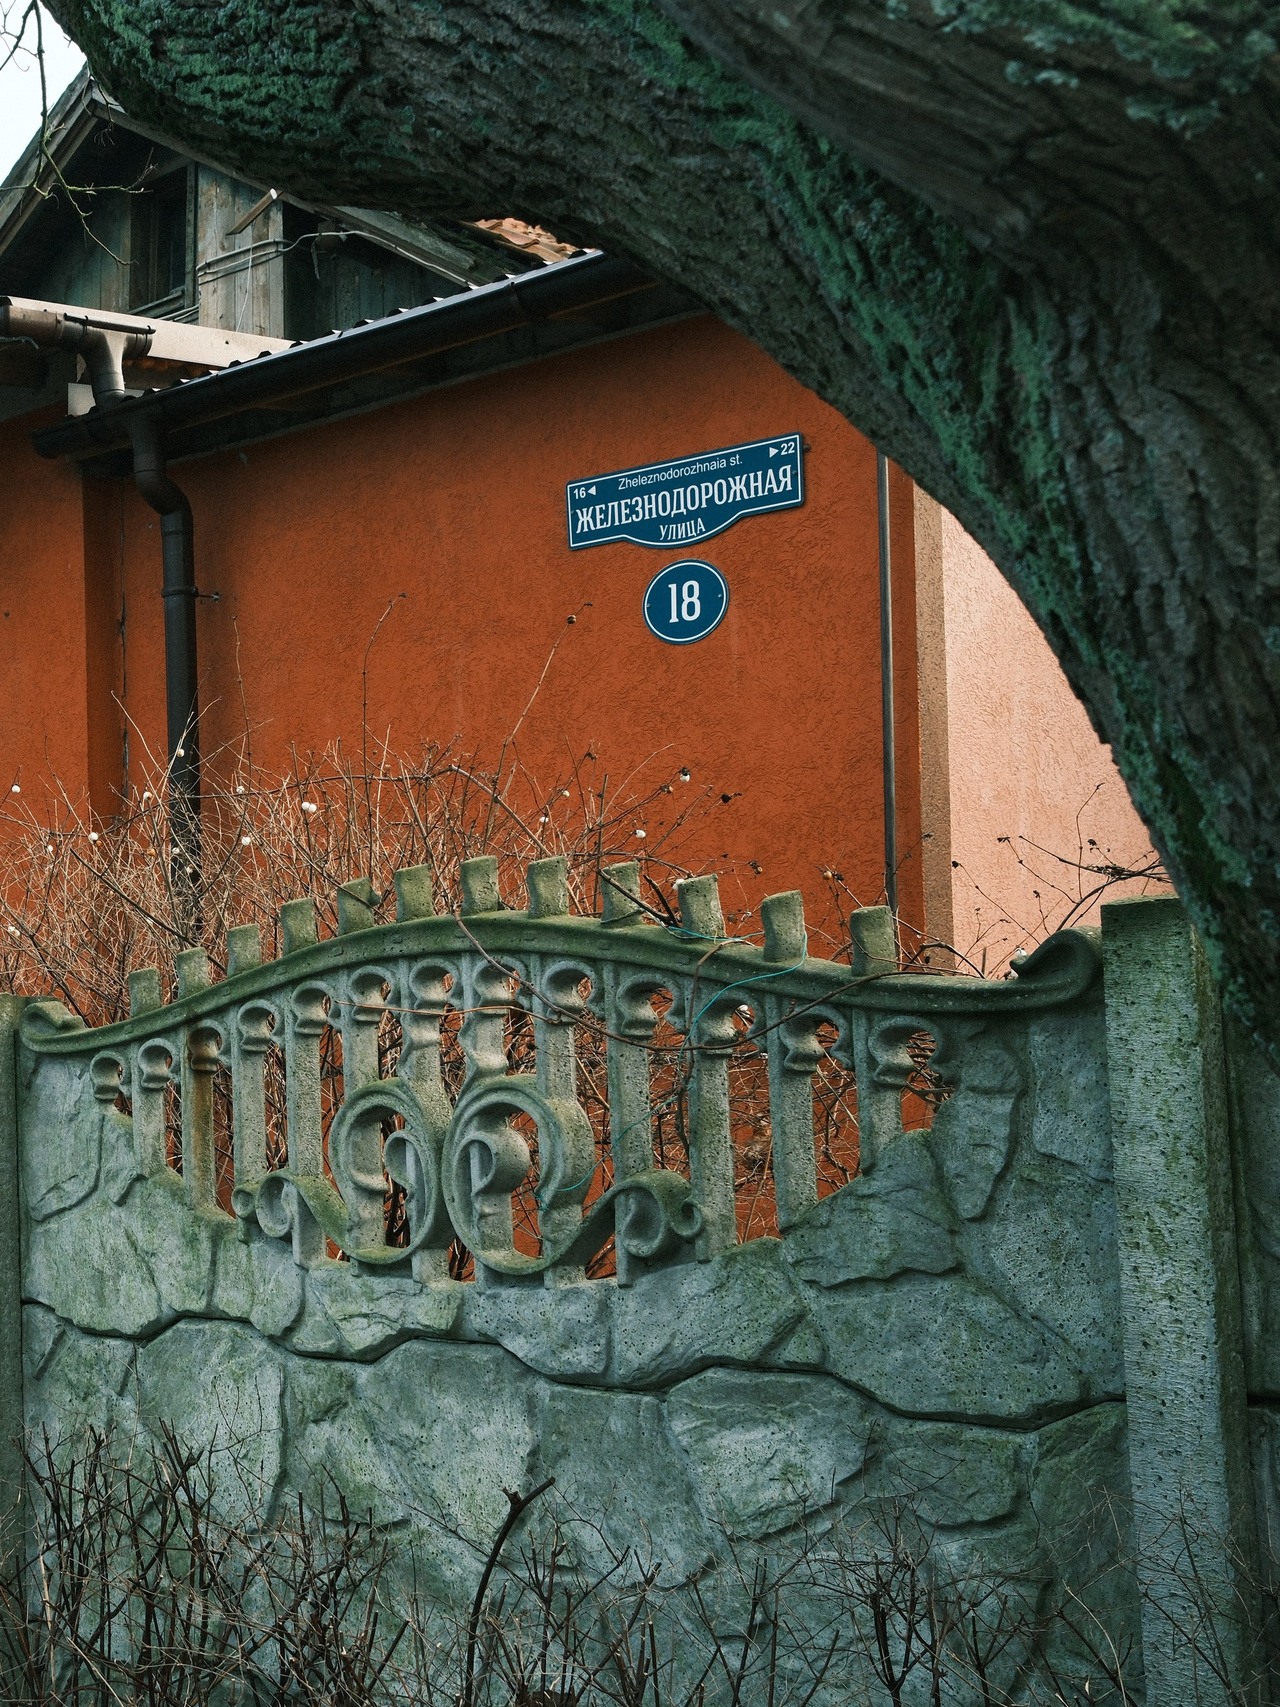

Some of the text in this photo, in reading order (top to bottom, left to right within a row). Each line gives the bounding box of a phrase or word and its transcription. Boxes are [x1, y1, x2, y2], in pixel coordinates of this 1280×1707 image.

[780, 442, 796, 456] 22
[618, 454, 743, 490] Zheleznodorozhnaia st.
[573, 486, 587, 500] 16
[575, 464, 793, 534] ЖЕЛЕЗНОДОРОЖНАЯ
[659, 517, 706, 541] УЛИЦА
[668, 580, 701, 623] 18
